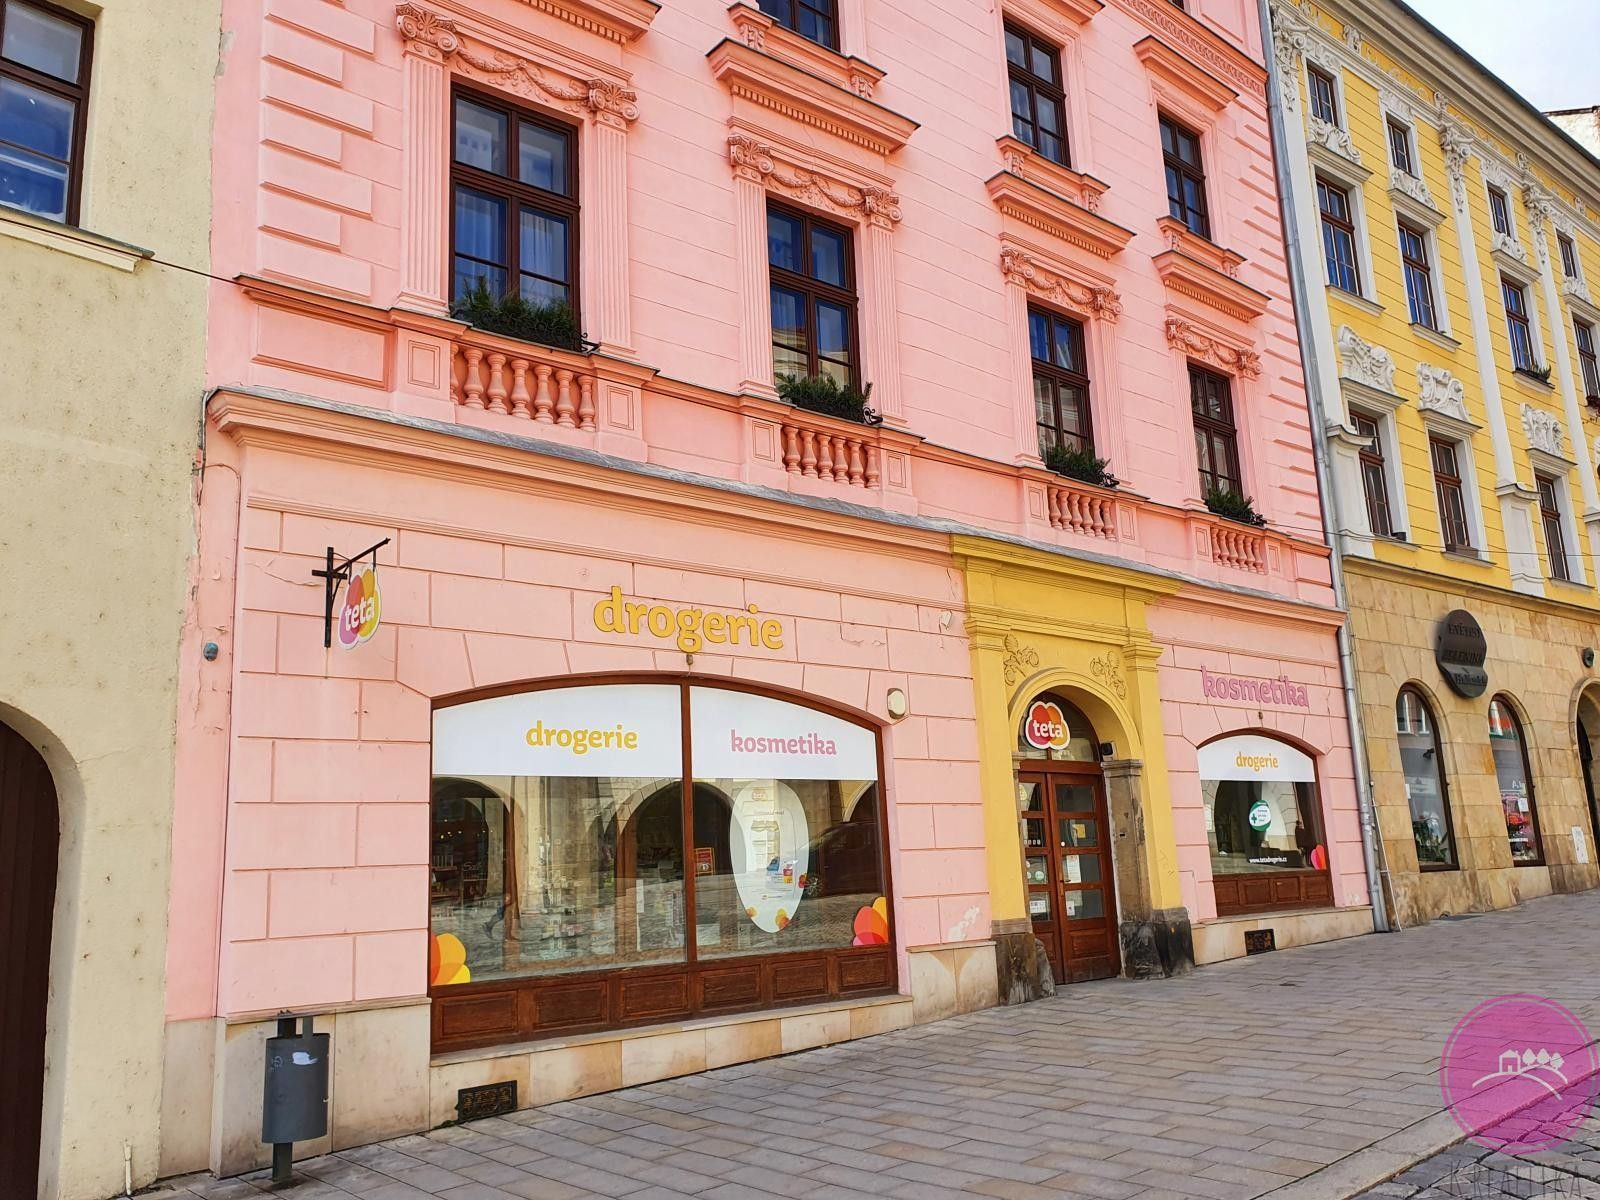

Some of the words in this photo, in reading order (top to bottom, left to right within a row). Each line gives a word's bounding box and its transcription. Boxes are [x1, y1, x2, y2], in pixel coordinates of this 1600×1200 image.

[345, 597, 375, 631] teta
[593, 585, 784, 653] drogerie
[1201, 665, 1310, 707] kosmetika
[526, 720, 638, 755] drogerie
[731, 729, 837, 755] kosmetika
[1033, 720, 1064, 738] teta
[1236, 752, 1279, 772] drogerie
